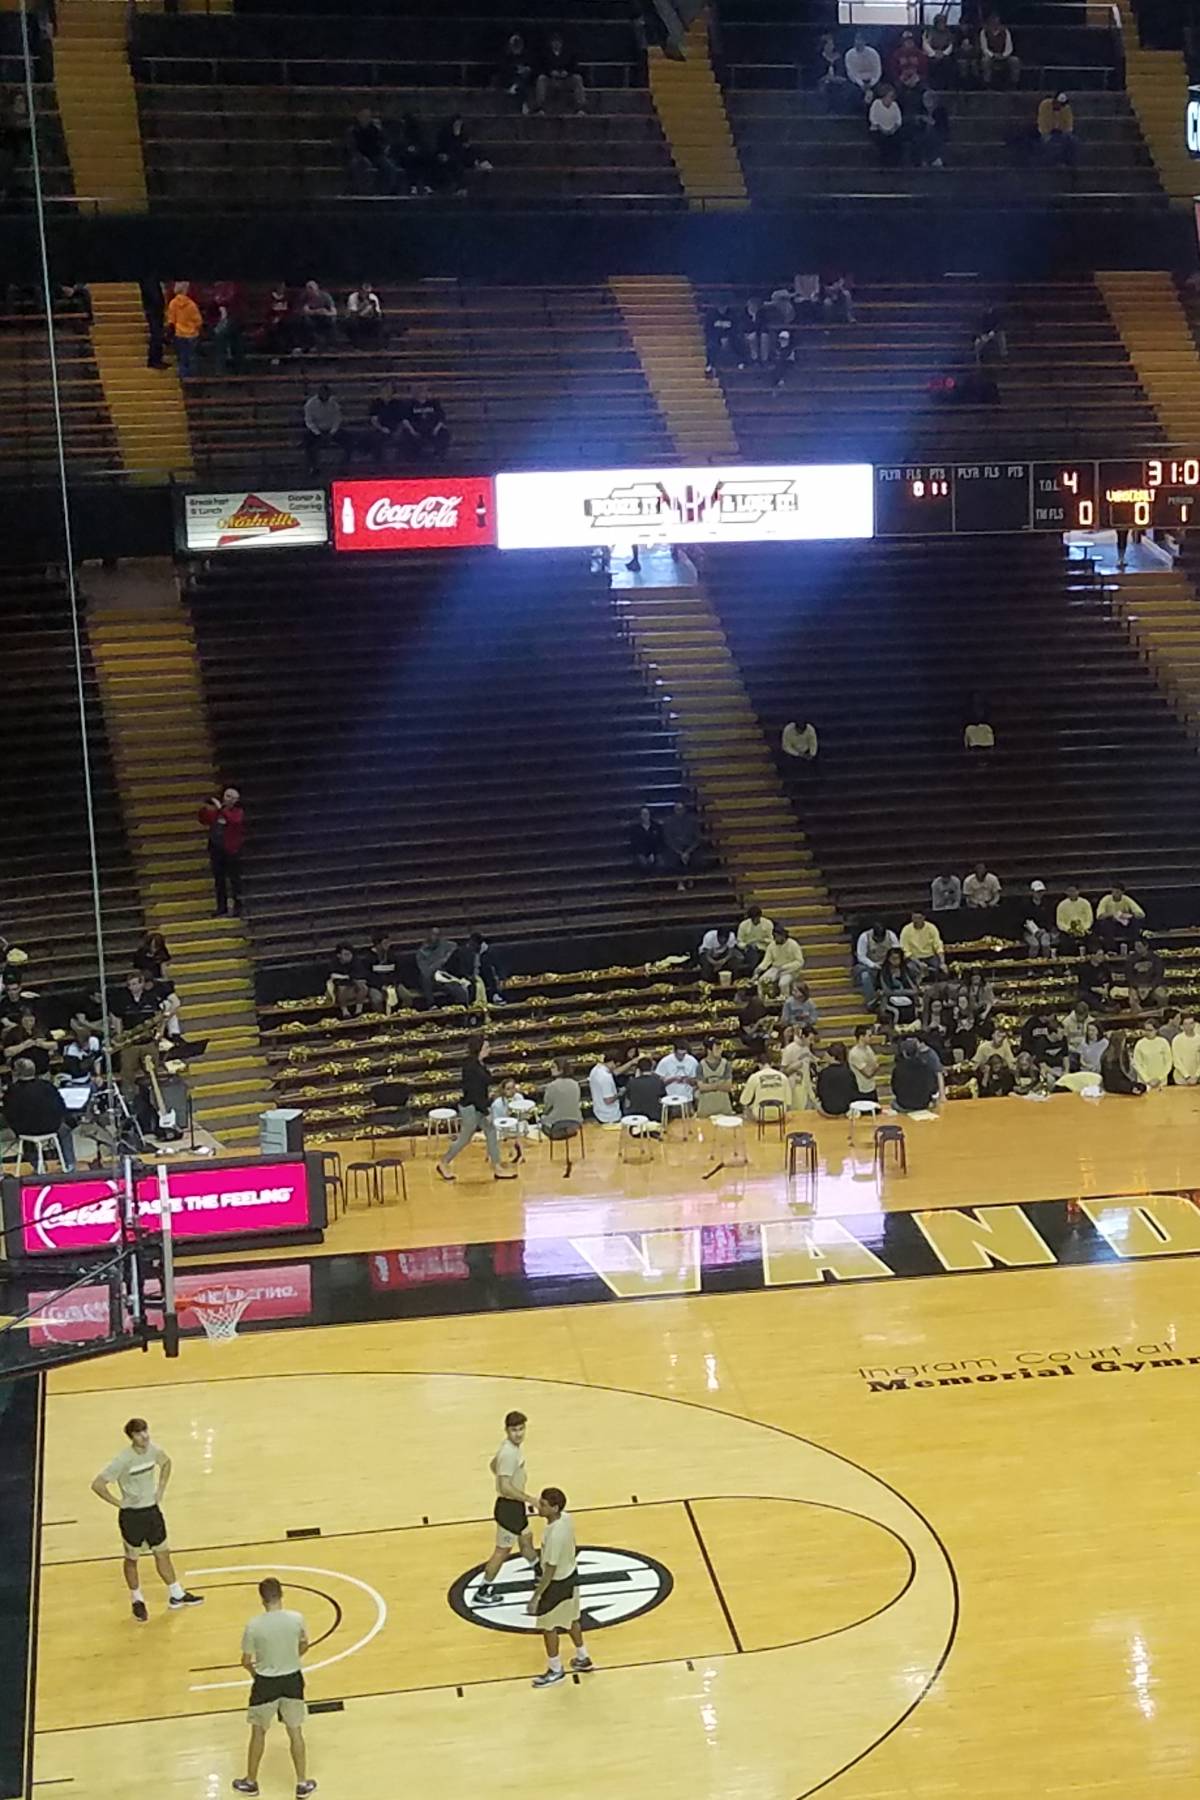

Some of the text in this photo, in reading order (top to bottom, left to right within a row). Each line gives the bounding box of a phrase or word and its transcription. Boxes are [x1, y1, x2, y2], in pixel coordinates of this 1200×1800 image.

[1063, 471, 1078, 494] 4
[1079, 501, 1093, 525] 0
[1134, 502, 1149, 525] 0
[184, 1195, 219, 1211] THE
[220, 1187, 294, 1206] FEELING
[858, 1341, 1178, 1380] Ingram Court at
[868, 1364, 1075, 1393] Memorial
